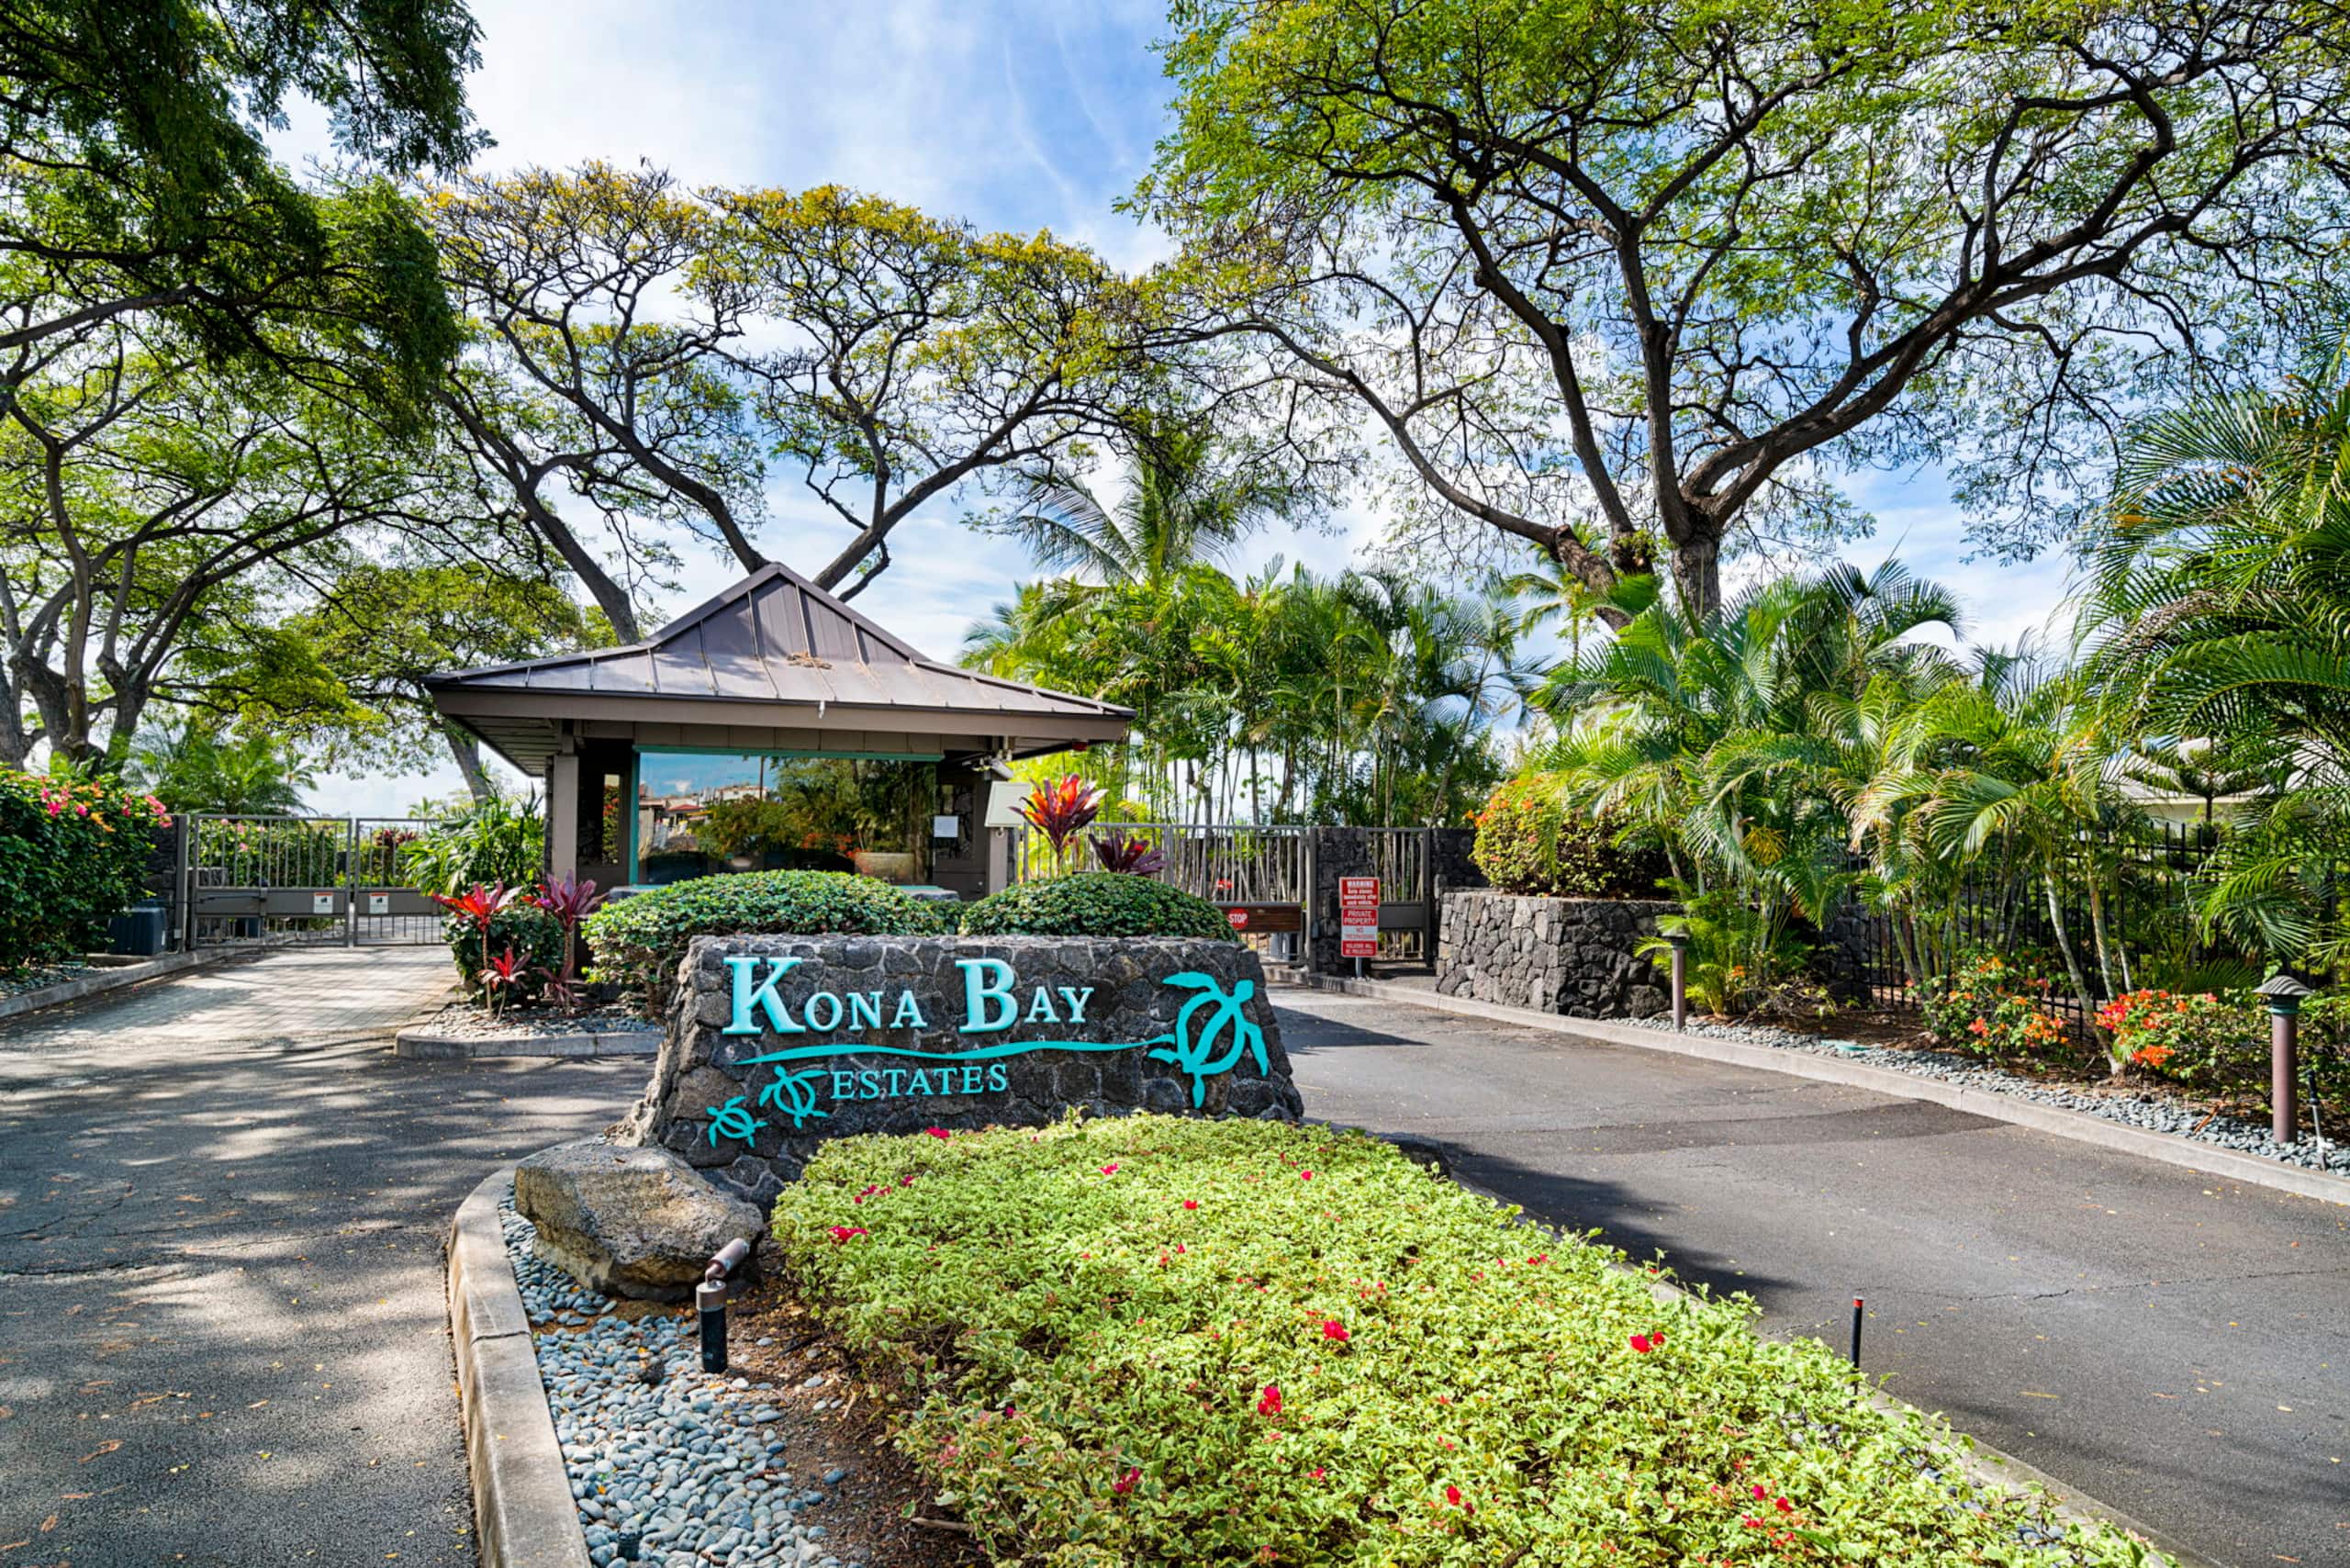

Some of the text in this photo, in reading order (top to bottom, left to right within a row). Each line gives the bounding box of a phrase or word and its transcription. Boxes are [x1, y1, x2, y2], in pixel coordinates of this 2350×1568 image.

[1228, 913, 1248, 924] STOP
[722, 957, 1095, 1035] KONA BAY
[829, 1063, 1008, 1100] ESTATES
